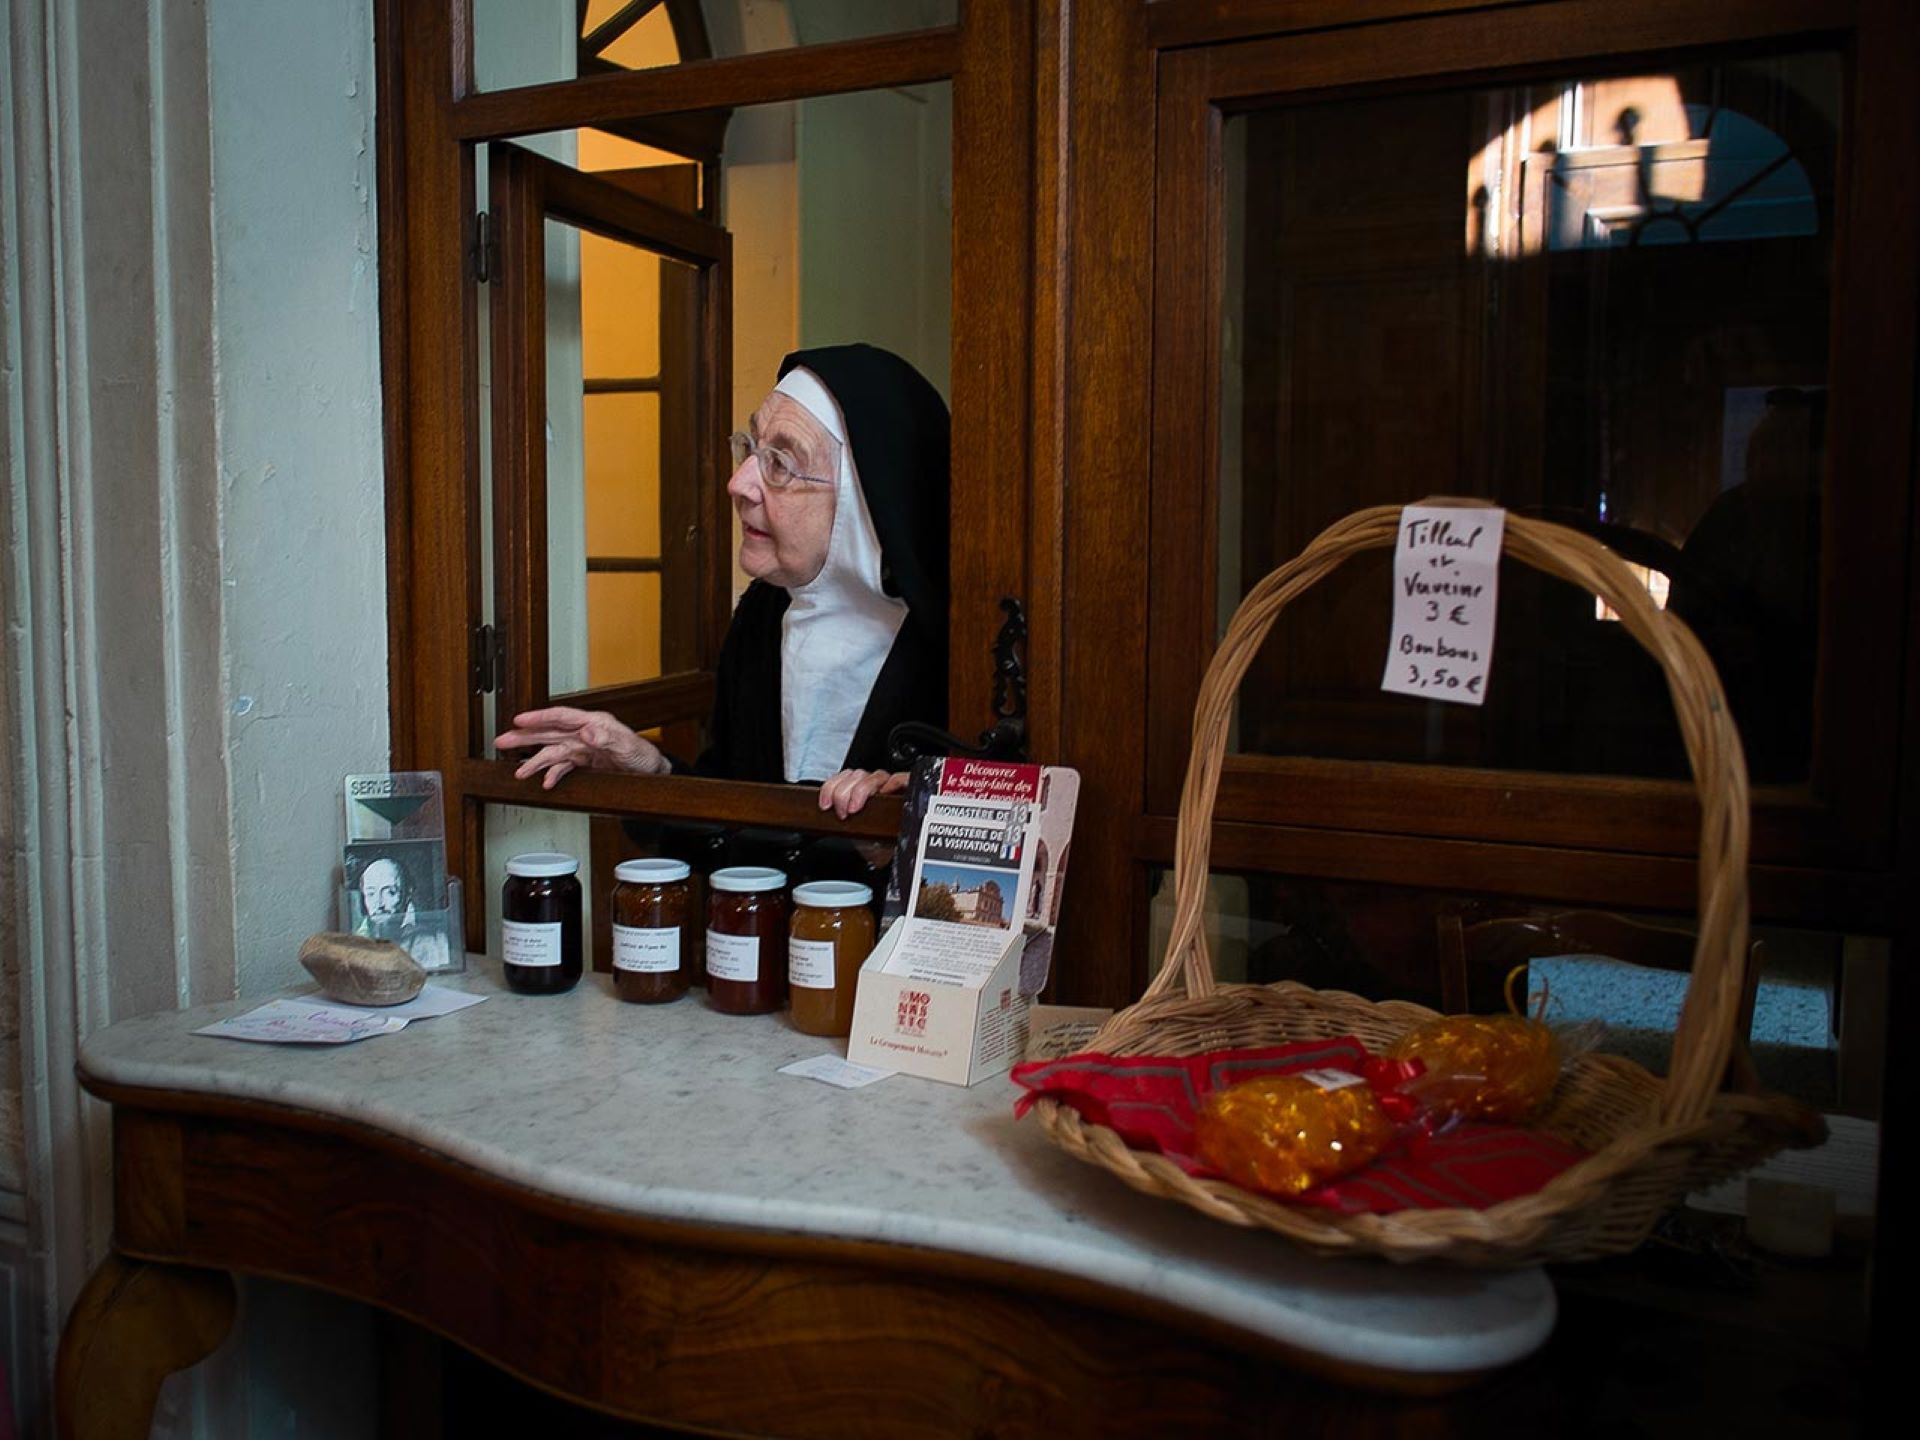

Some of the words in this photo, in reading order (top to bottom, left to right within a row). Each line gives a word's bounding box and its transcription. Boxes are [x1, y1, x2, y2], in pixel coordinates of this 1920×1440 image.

[1407, 518, 1484, 549] Tilleul
[1425, 600, 1439, 622] 3
[1449, 605, 1470, 626] €
[1400, 633, 1479, 662] Bonbons
[963, 763, 1016, 779] Découvrez
[947, 774, 957, 784] le
[957, 776, 1014, 791] Savoir-faire
[1015, 779, 1033, 792] des
[996, 810, 1010, 821] DE
[1012, 804, 1028, 822] 13
[990, 831, 1003, 842] DE
[1005, 825, 1021, 843] 13
[929, 837, 943, 848] LA
[944, 838, 1000, 854] VISITATION
[909, 991, 930, 1005] MO
[898, 1002, 928, 1016] NAS
